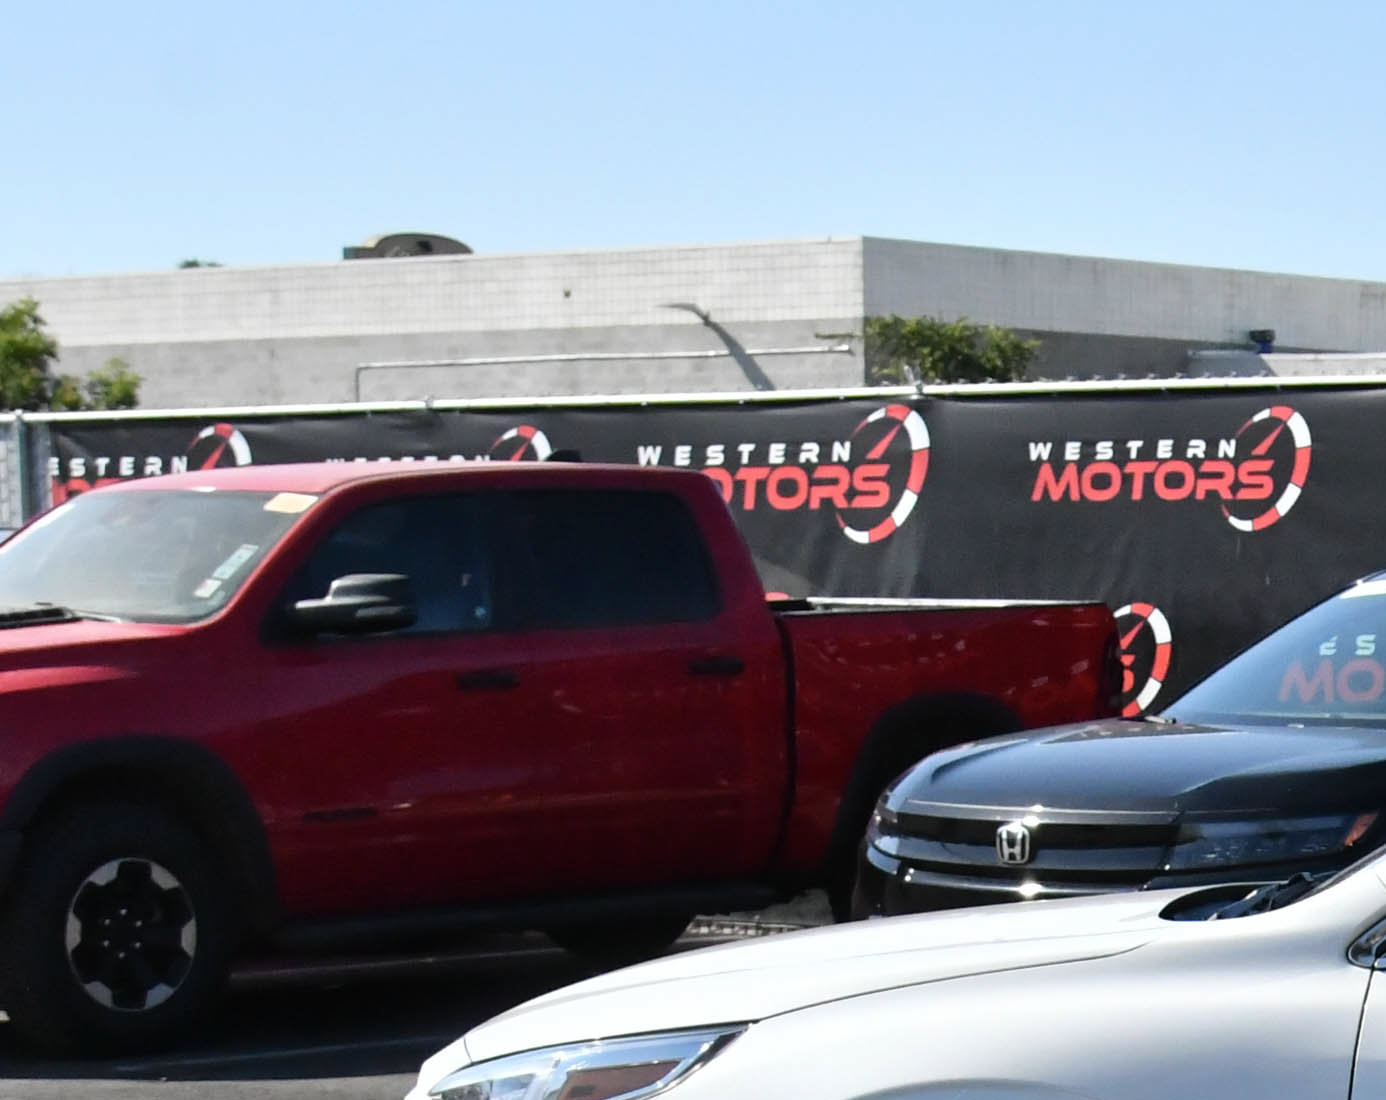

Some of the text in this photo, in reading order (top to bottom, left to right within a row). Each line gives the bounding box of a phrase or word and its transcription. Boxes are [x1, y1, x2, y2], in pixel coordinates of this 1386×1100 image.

[637, 441, 851, 466] WESTERN
[1029, 439, 1237, 461] WESTERN
[1031, 459, 1275, 501] MOTORS
